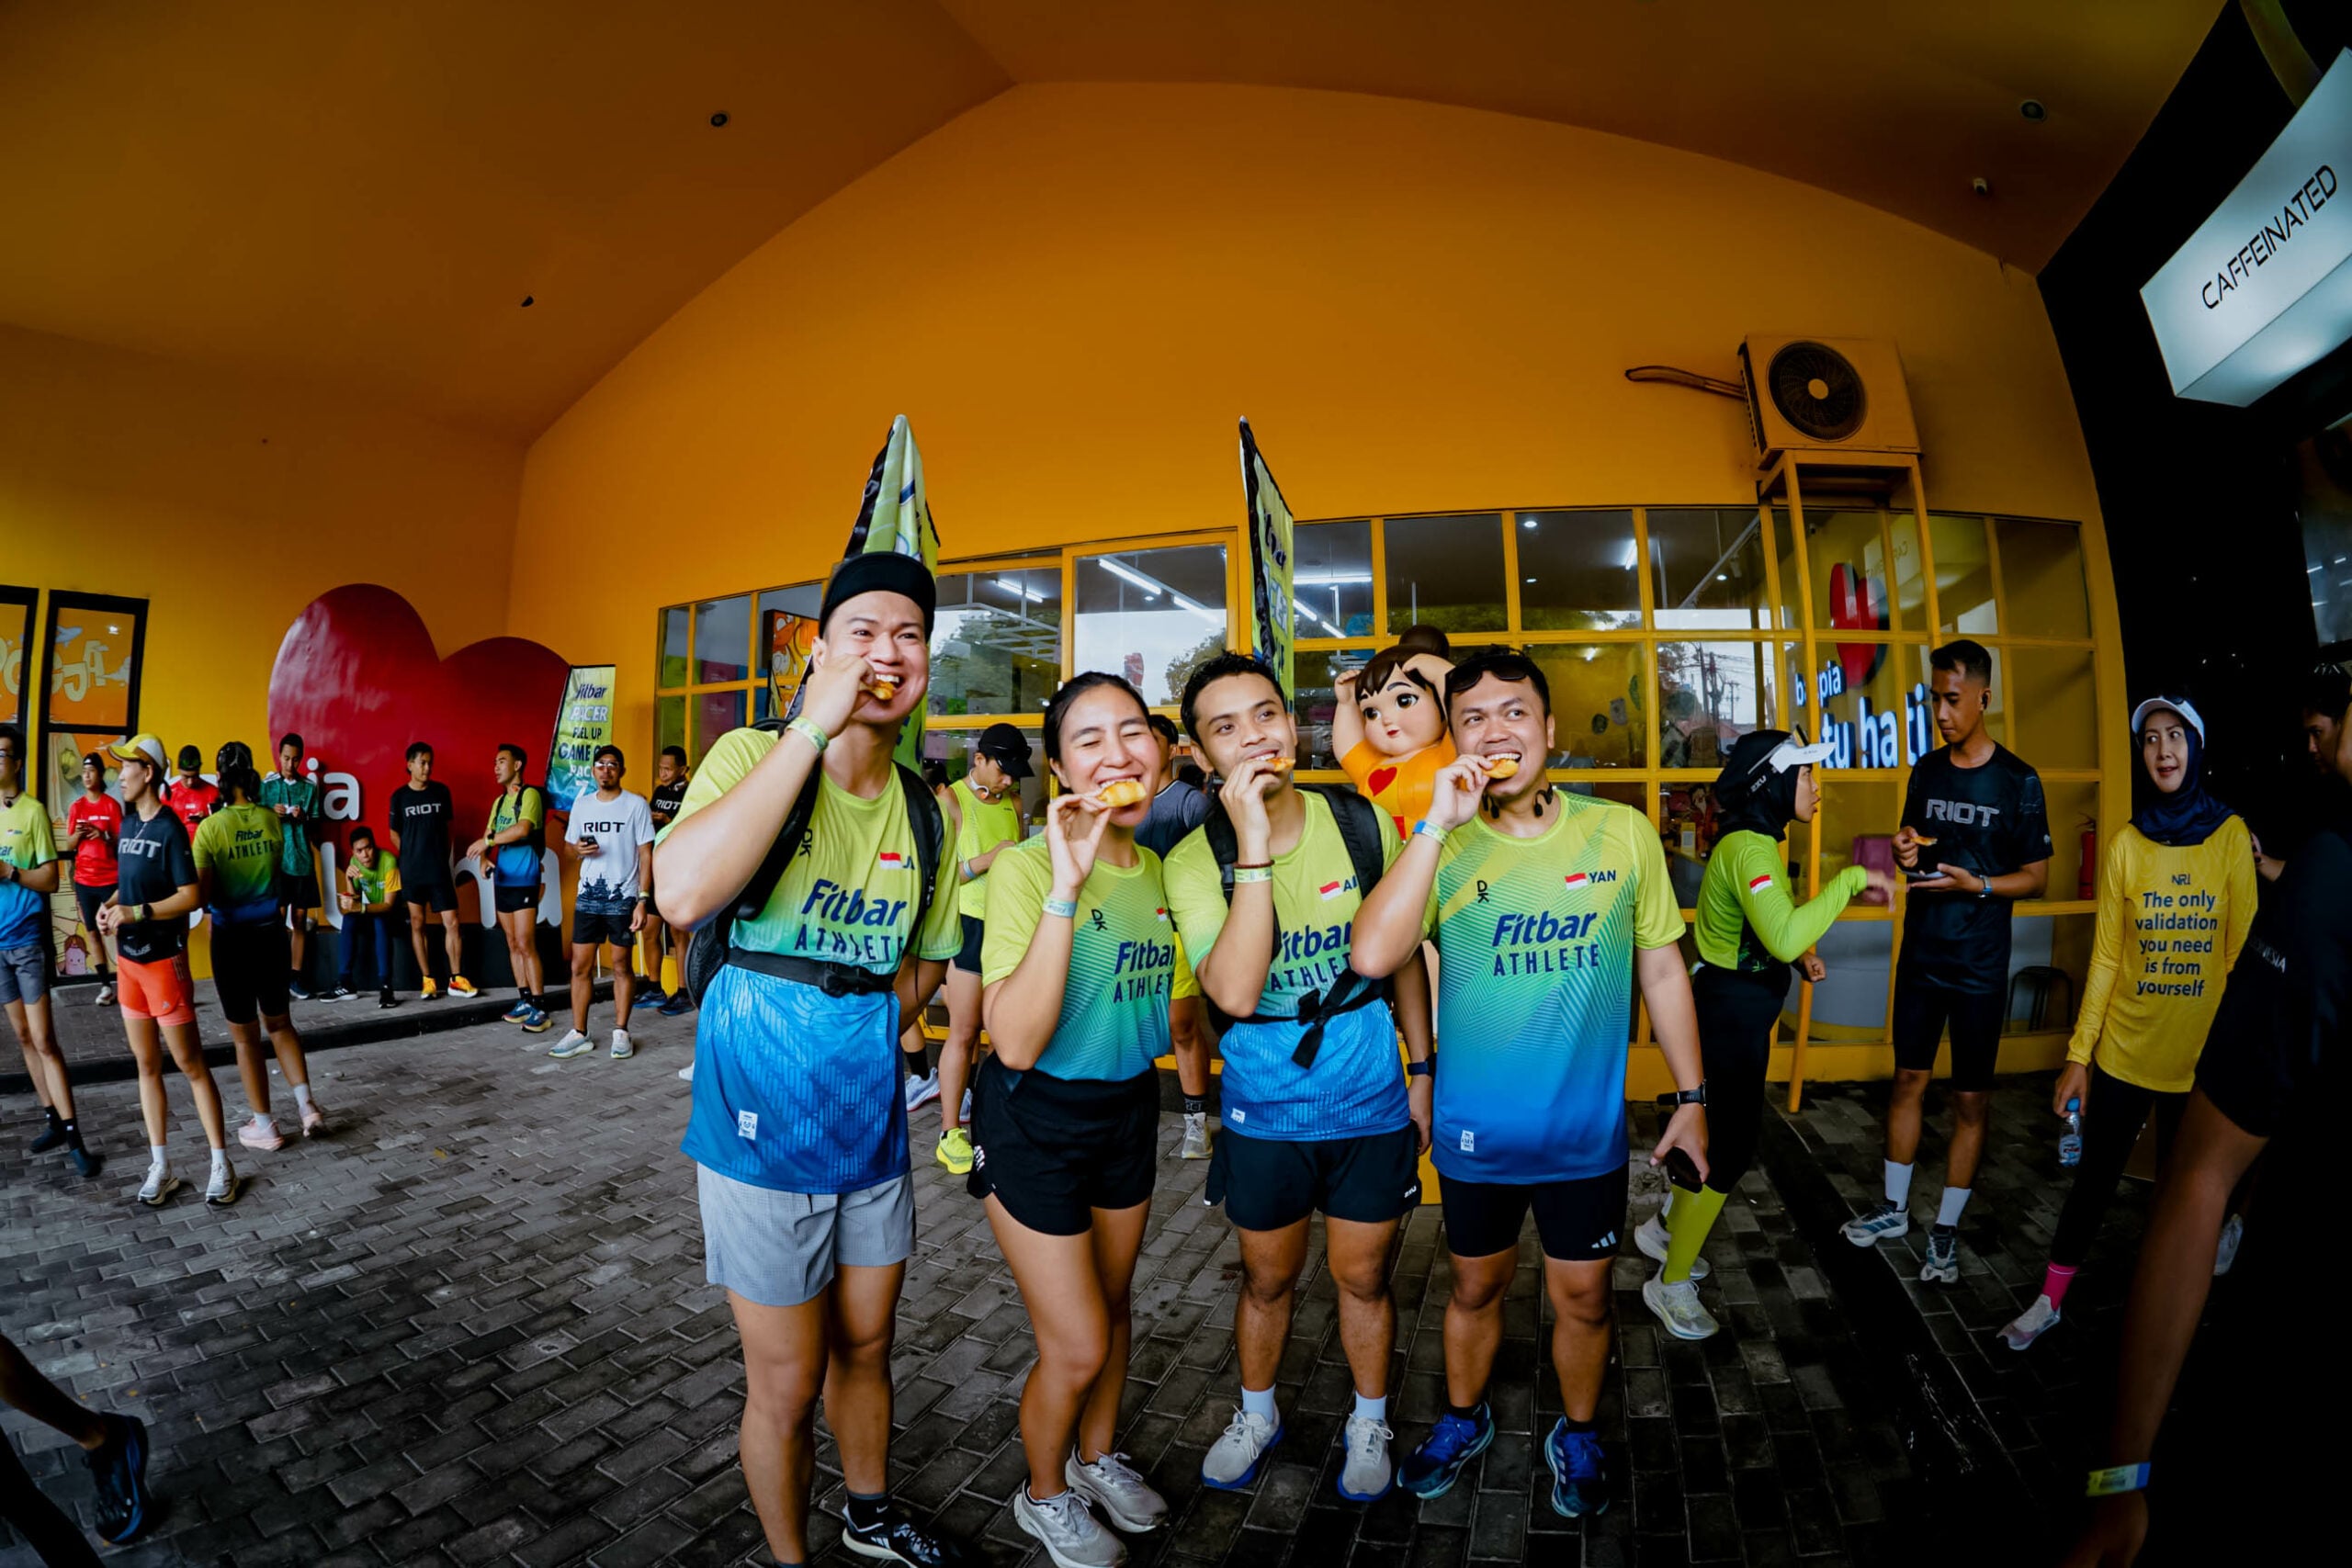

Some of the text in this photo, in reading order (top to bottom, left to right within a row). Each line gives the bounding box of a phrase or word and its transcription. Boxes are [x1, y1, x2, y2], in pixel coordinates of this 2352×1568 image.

[2201, 164, 2338, 310] CAFFEINATED
[591, 727, 603, 739] UP
[558, 742, 591, 761] GAME
[570, 763, 594, 778] PAC
[404, 803, 442, 818] RIOT
[655, 798, 682, 810] RIOT
[1925, 798, 2001, 828] RIOT
[235, 829, 264, 842] Fitbar
[583, 821, 626, 833] RIOT
[118, 838, 162, 858] RIOT
[1589, 869, 1617, 884] YAN
[800, 878, 908, 928] Fitbar
[2143, 889, 2216, 913] The only
[1491, 910, 1598, 947] Fitbar
[2134, 912, 2218, 931] validation
[1282, 920, 1353, 964] itbar
[2139, 935, 2213, 954] you need
[1493, 943, 1600, 976] ATHLETE
[2144, 956, 2201, 976] is from
[1270, 952, 1352, 992] ATHLET
[1113, 971, 1174, 1004] ATHLET
[2136, 979, 2205, 998] yourself
